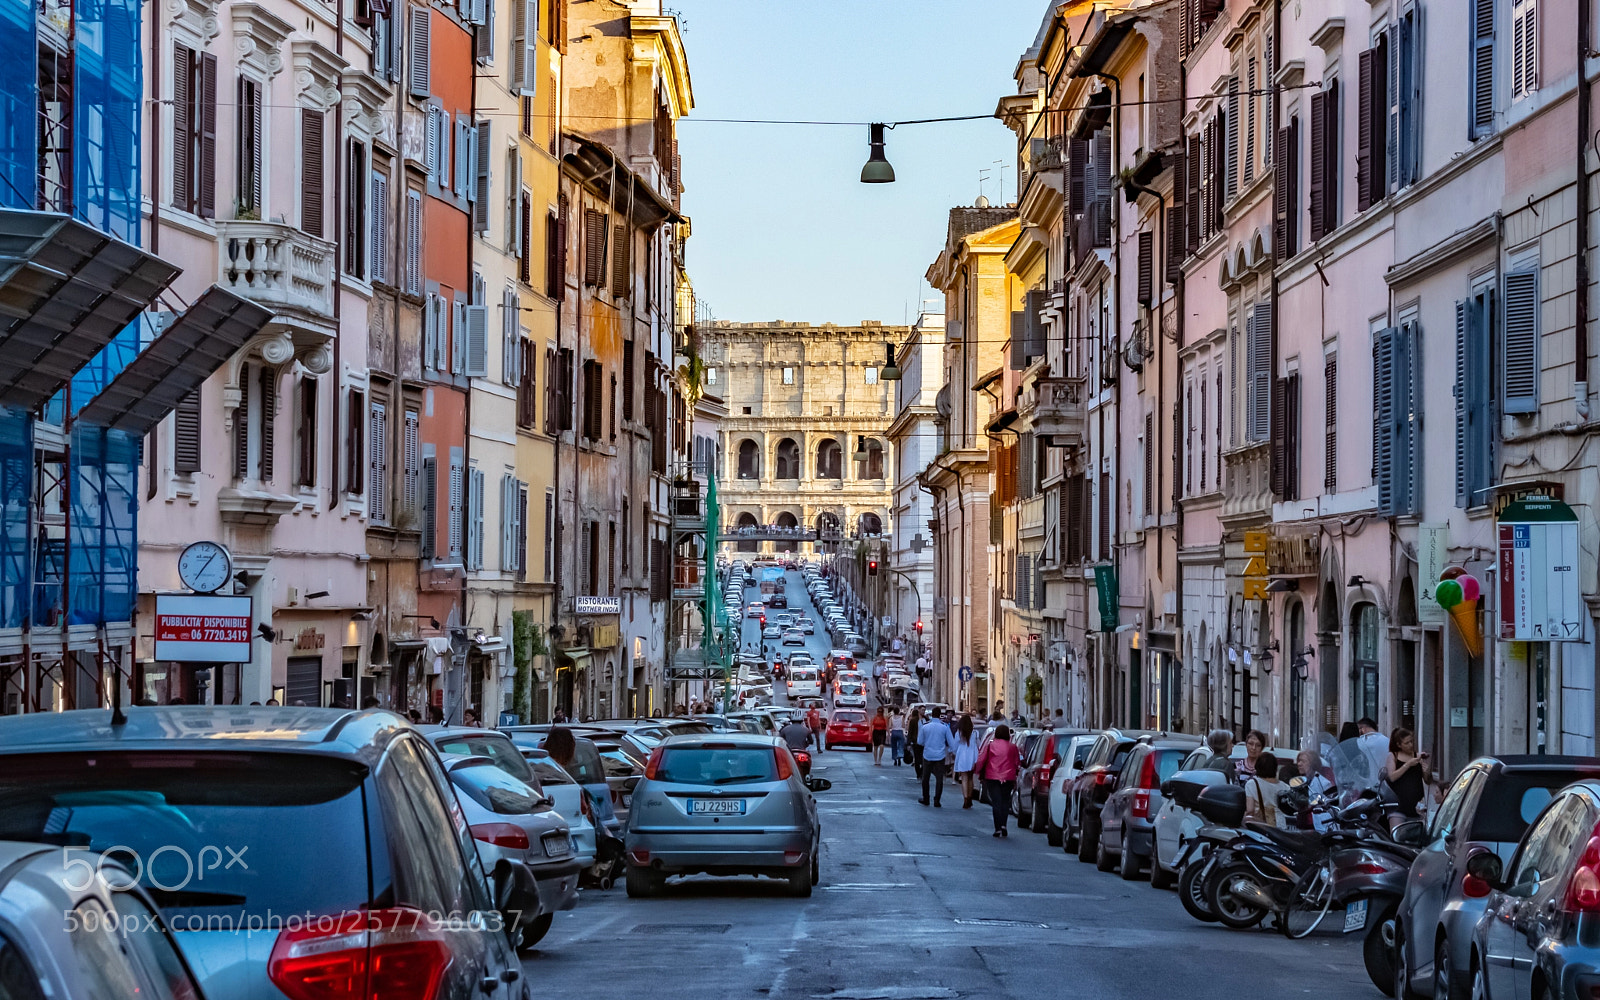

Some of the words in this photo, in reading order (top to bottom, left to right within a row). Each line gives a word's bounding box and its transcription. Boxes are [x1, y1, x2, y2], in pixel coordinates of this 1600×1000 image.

[1516, 530, 1523, 539] U
[578, 597, 618, 605] RISTORANTE
[161, 616, 203, 627] PUBBLICITA'
[204, 617, 247, 628] DISPONIBILE
[190, 629, 202, 640] 06
[204, 629, 248, 641] 7720.3419
[694, 801, 706, 811] CJ
[708, 802, 739, 812] 229HS
